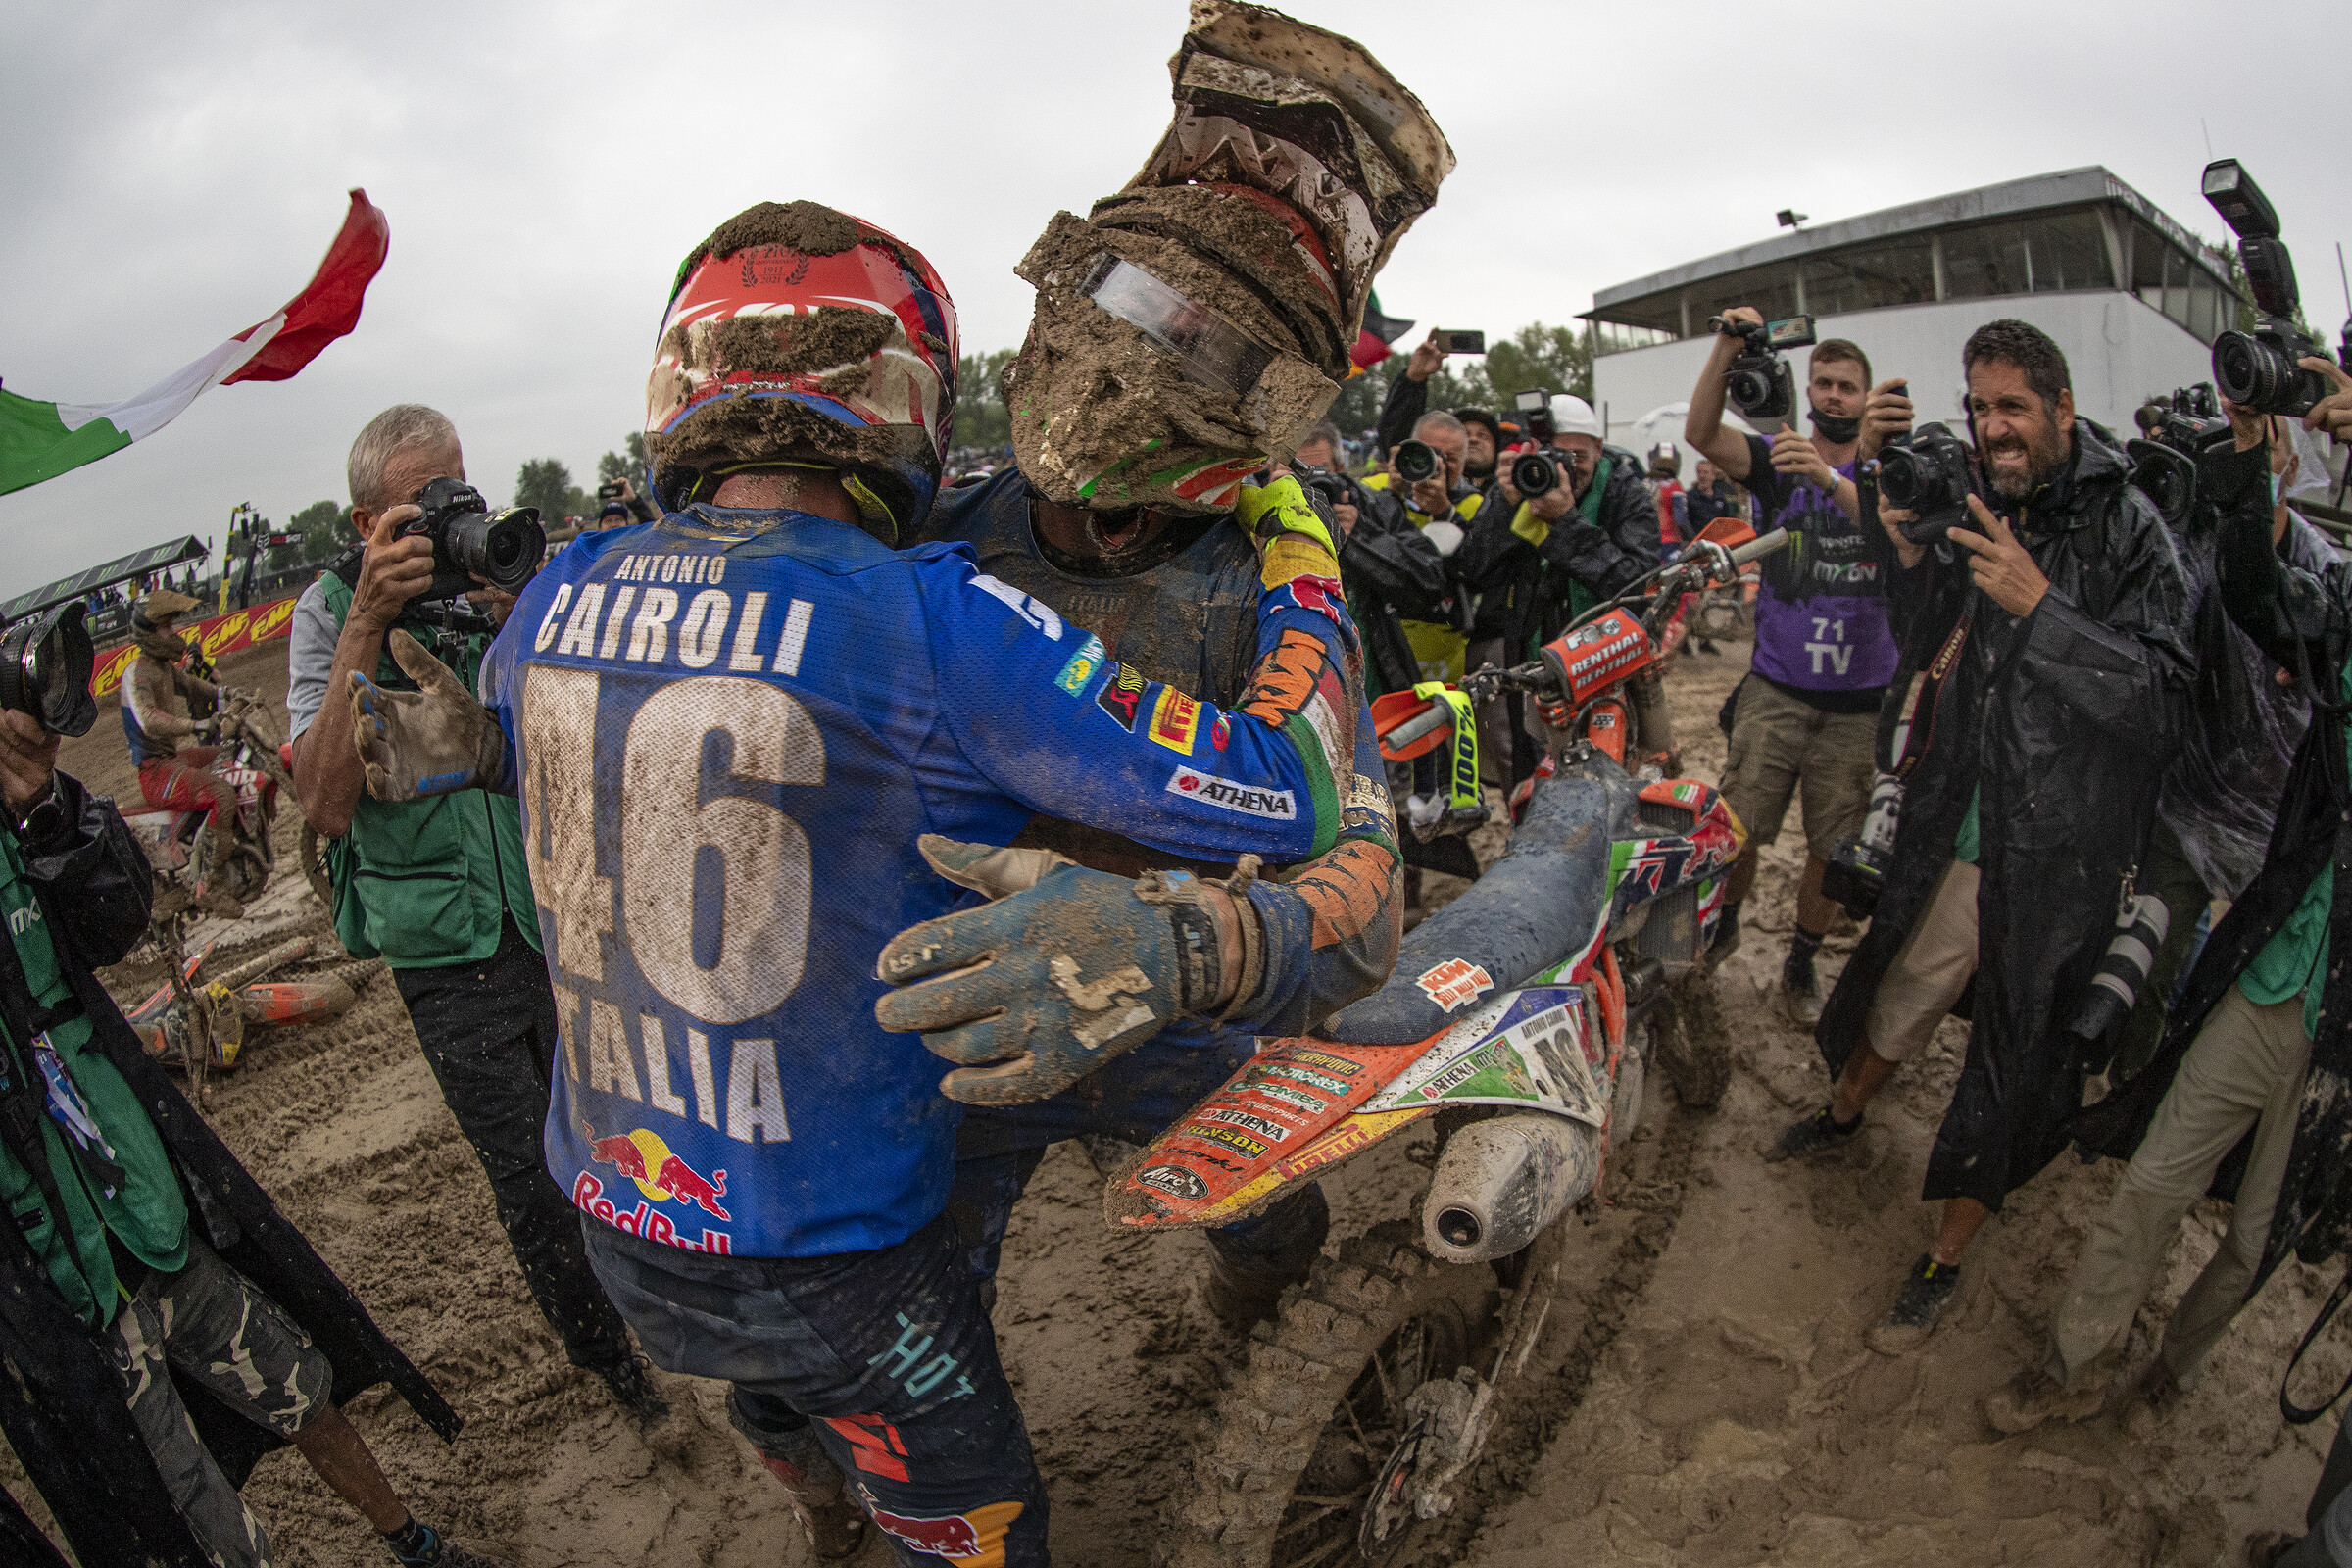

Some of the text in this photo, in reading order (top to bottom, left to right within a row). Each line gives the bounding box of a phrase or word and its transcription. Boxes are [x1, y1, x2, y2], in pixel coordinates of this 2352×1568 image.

[452, 494, 472, 503] Nikon
[614, 554, 727, 585] ANTONIO
[203, 612, 249, 657] FMF
[250, 598, 298, 642] FMF
[534, 582, 815, 677] CAIROLI
[1812, 617, 1844, 642] 71
[1570, 631, 1642, 676] RENTHAL
[1575, 646, 1643, 689] RENTHAL
[1804, 642, 1854, 675] TV
[1454, 703, 1476, 799] 100%
[1200, 782, 1290, 814] ATHENA
[521, 664, 827, 1025] 46
[1422, 959, 1473, 992] KTM
[556, 983, 792, 1144] TALIA
[1432, 1062, 1480, 1094] ATHENA
[1214, 1109, 1285, 1142] ATHENA
